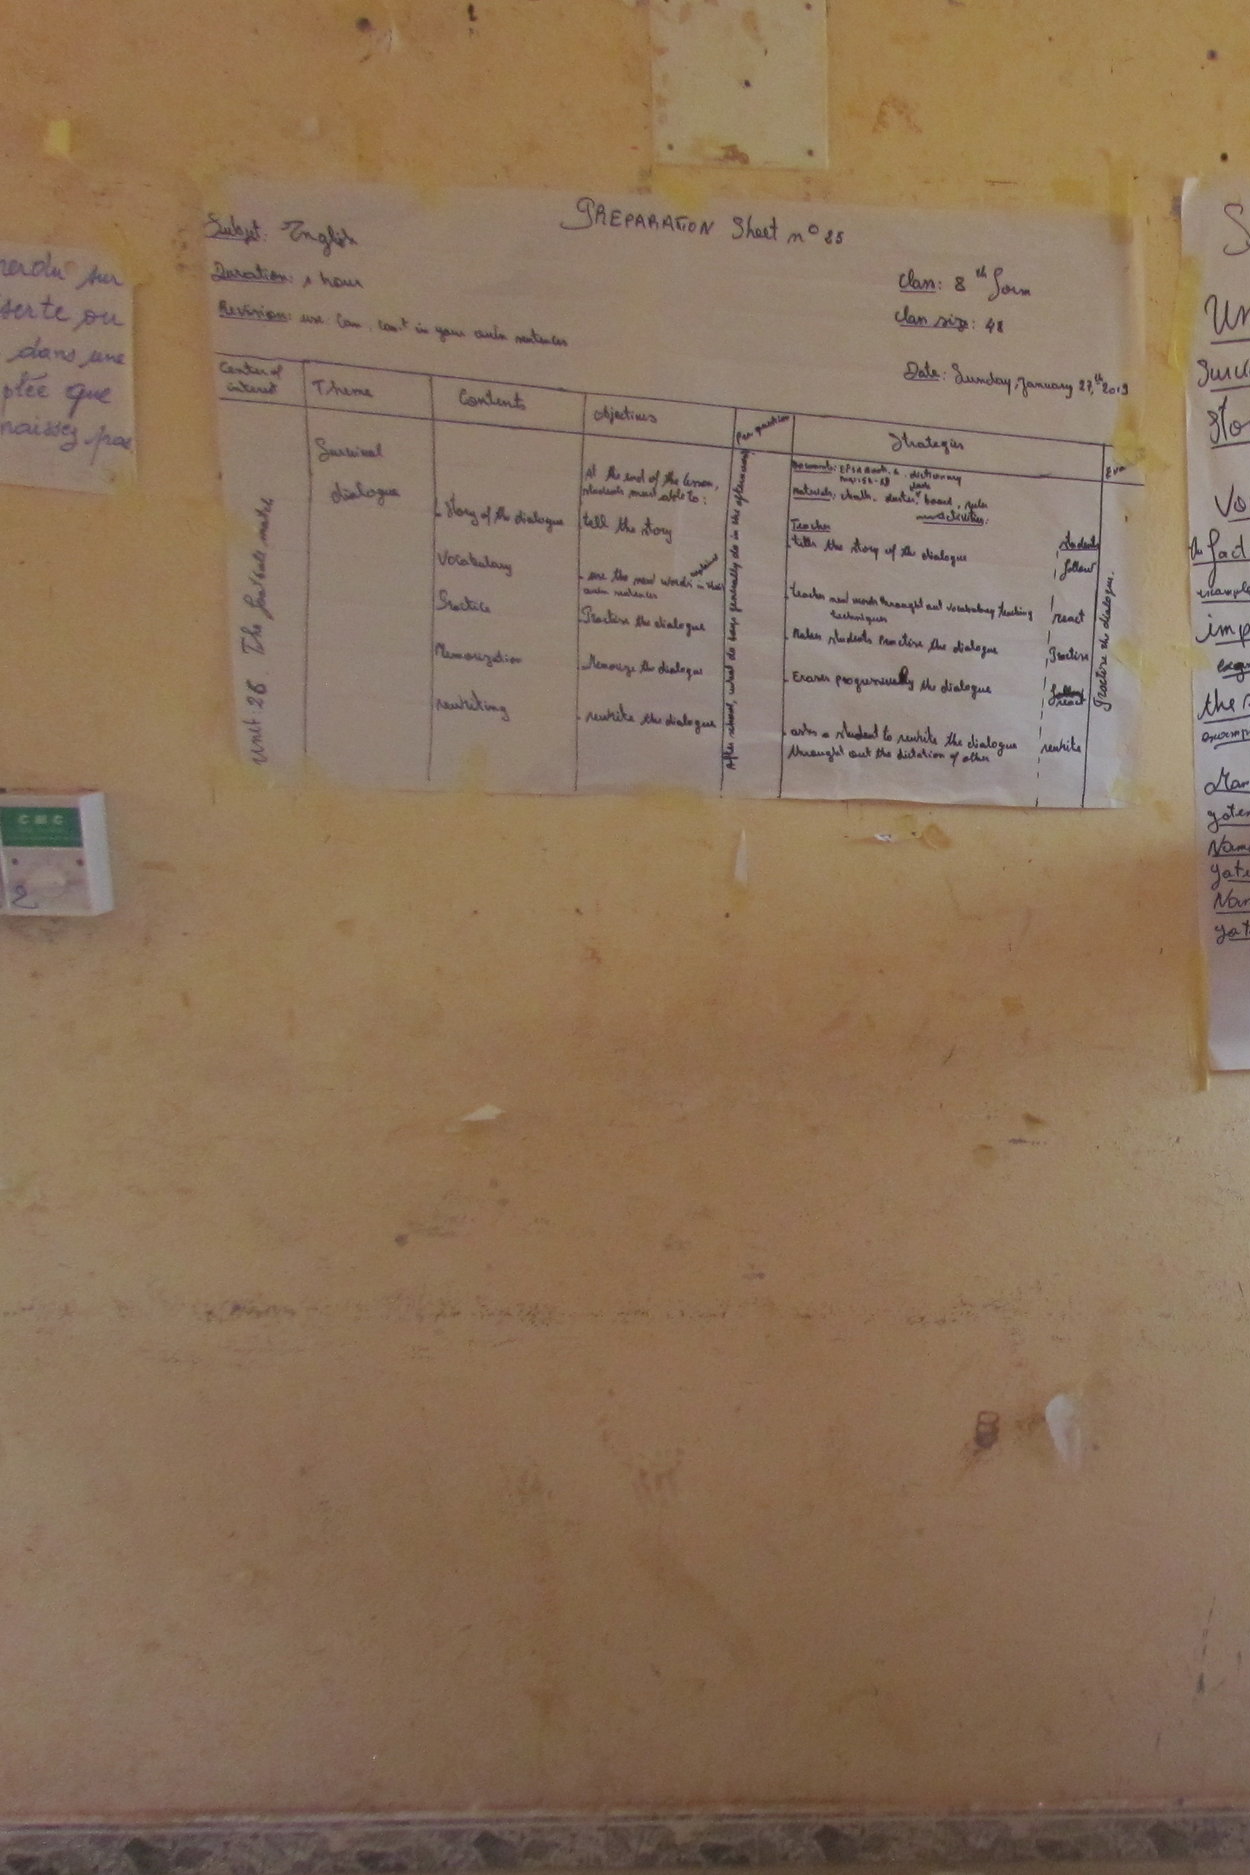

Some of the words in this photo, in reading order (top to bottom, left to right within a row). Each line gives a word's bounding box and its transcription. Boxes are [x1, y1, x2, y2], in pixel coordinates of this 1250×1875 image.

[561, 197, 715, 236] PREPARATION
[732, 215, 779, 241] Sheet
[312, 379, 374, 398] Theme
[458, 388, 527, 411] Contents
[1197, 687, 1235, 720] the
